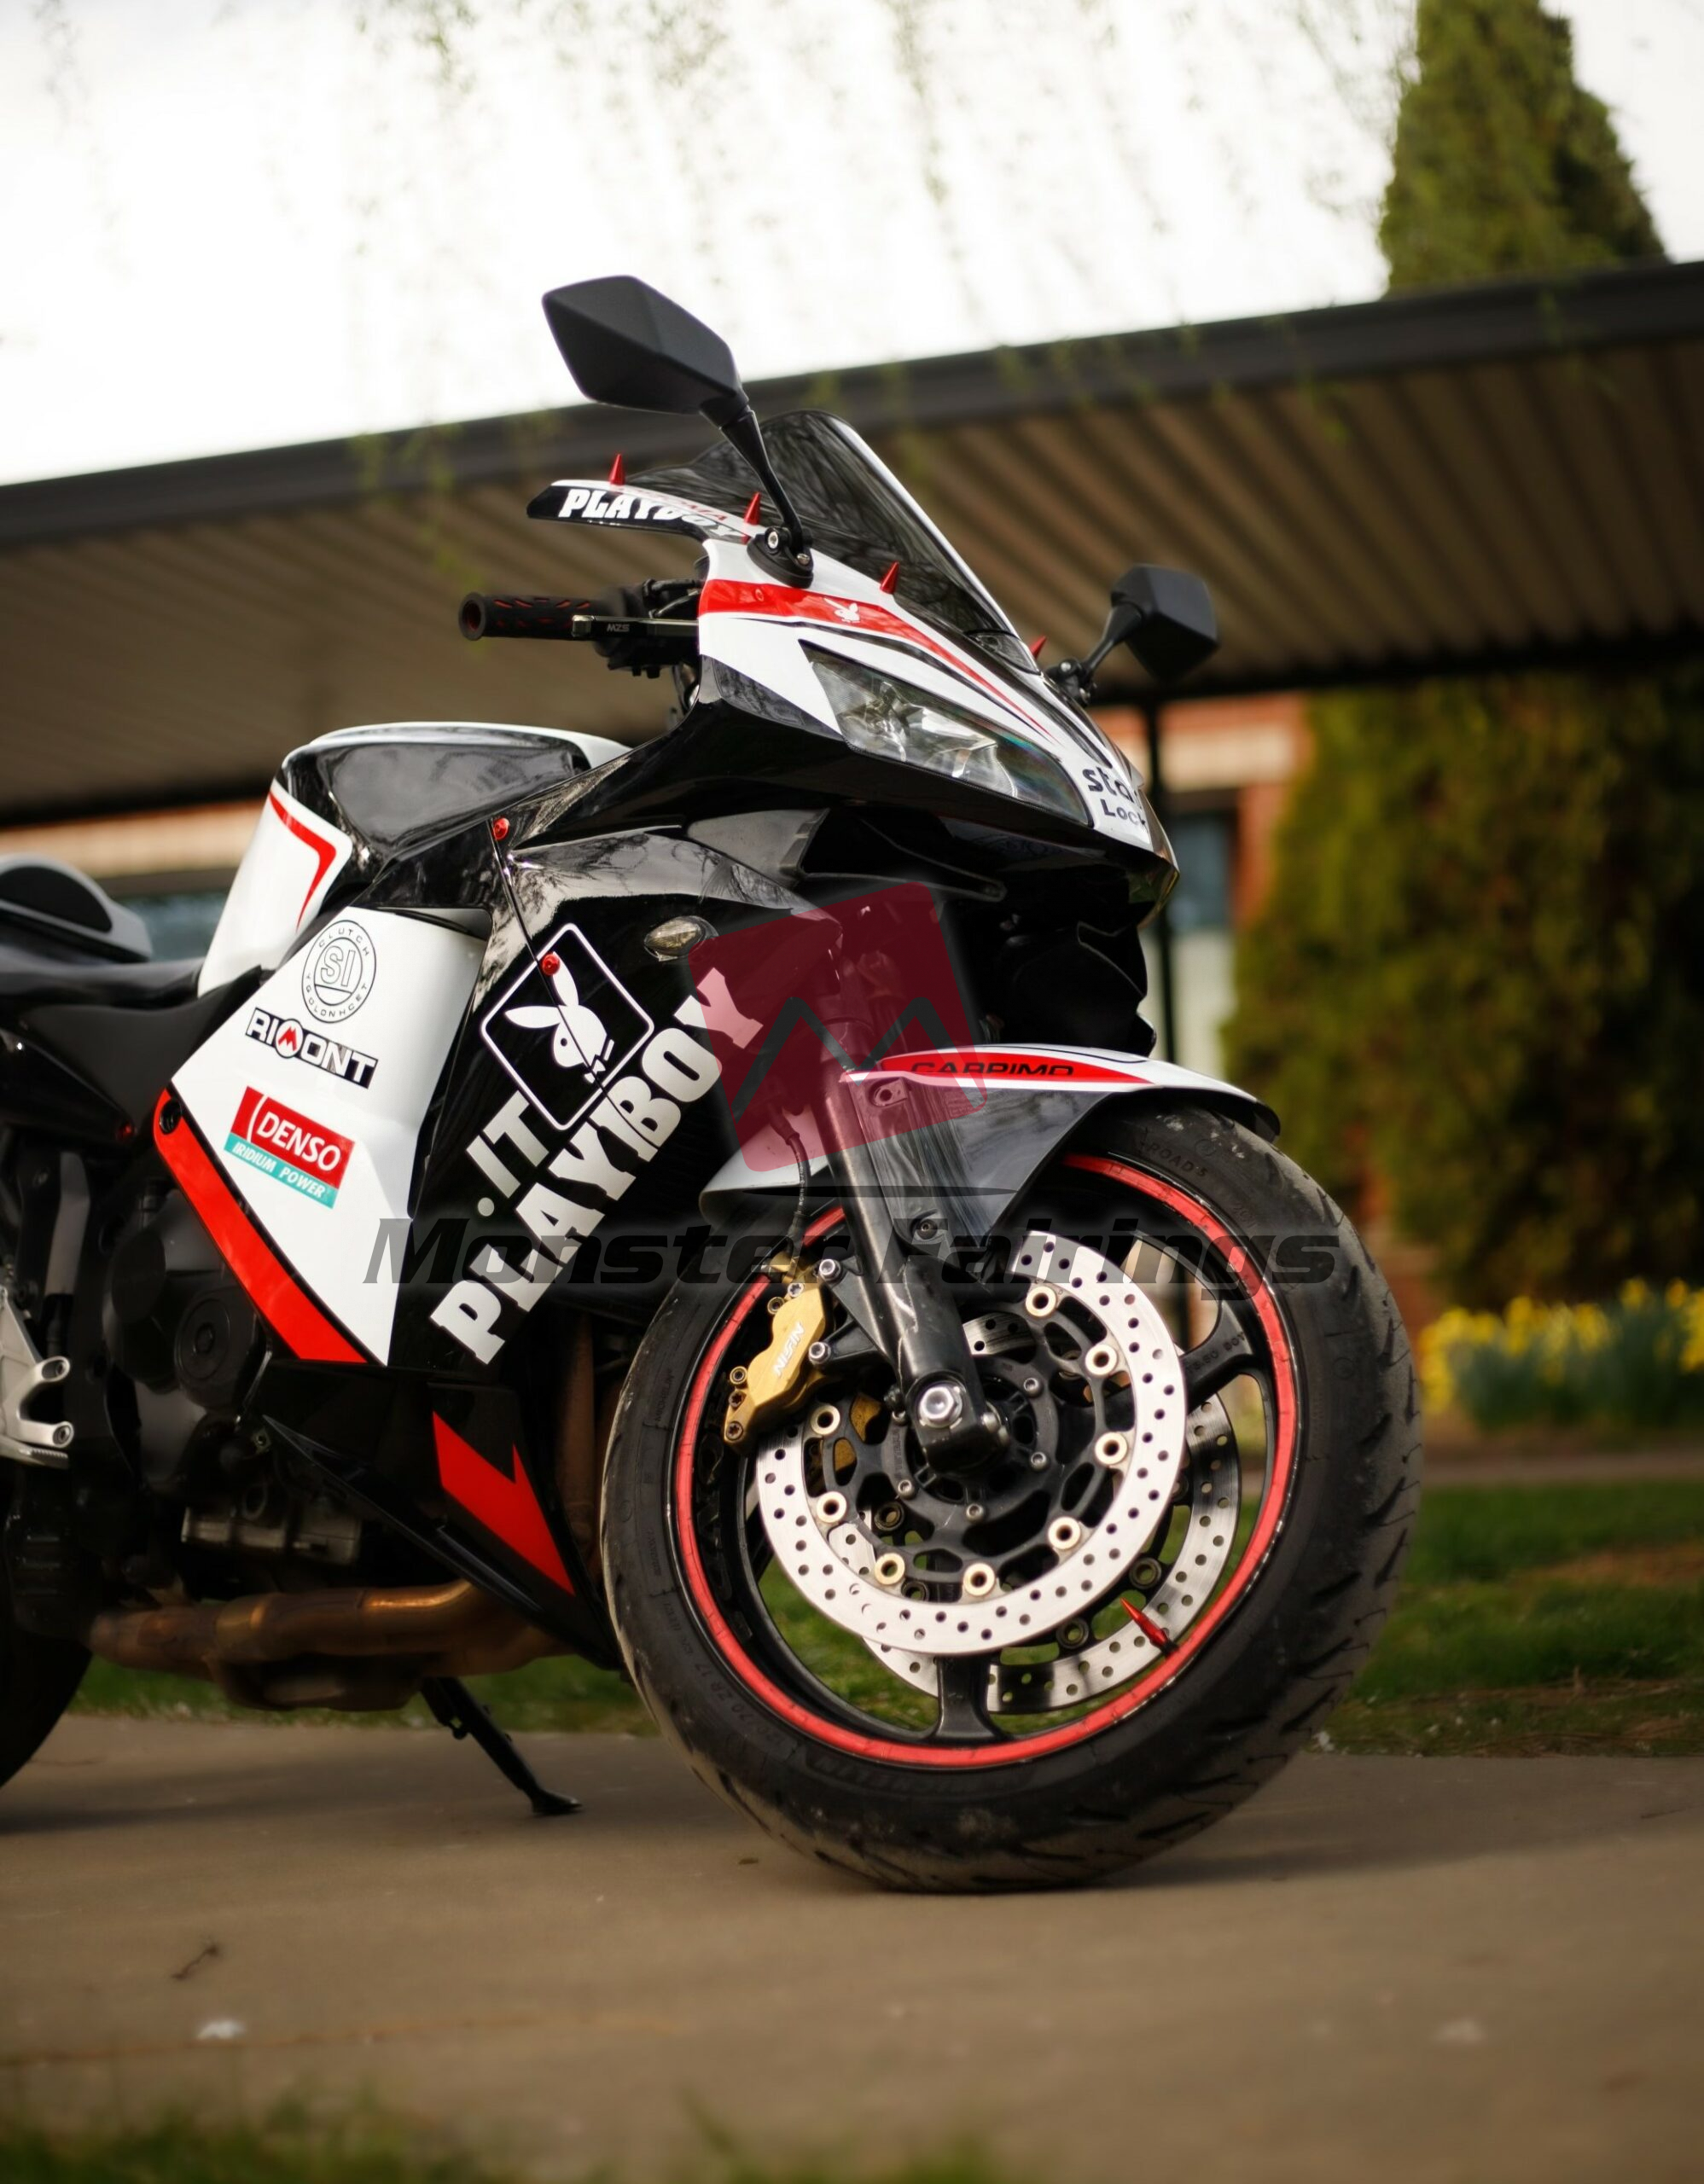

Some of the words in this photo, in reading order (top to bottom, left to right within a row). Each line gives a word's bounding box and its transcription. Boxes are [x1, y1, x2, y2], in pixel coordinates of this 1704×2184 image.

[318, 927, 370, 956] CLUTCH
[320, 944, 357, 988] SI
[231, 1141, 277, 1173] IRIDIUM
[279, 1166, 327, 1199] POWER
[256, 1110, 342, 1172] DENSO
[429, 967, 765, 1366] PLAYBOY
